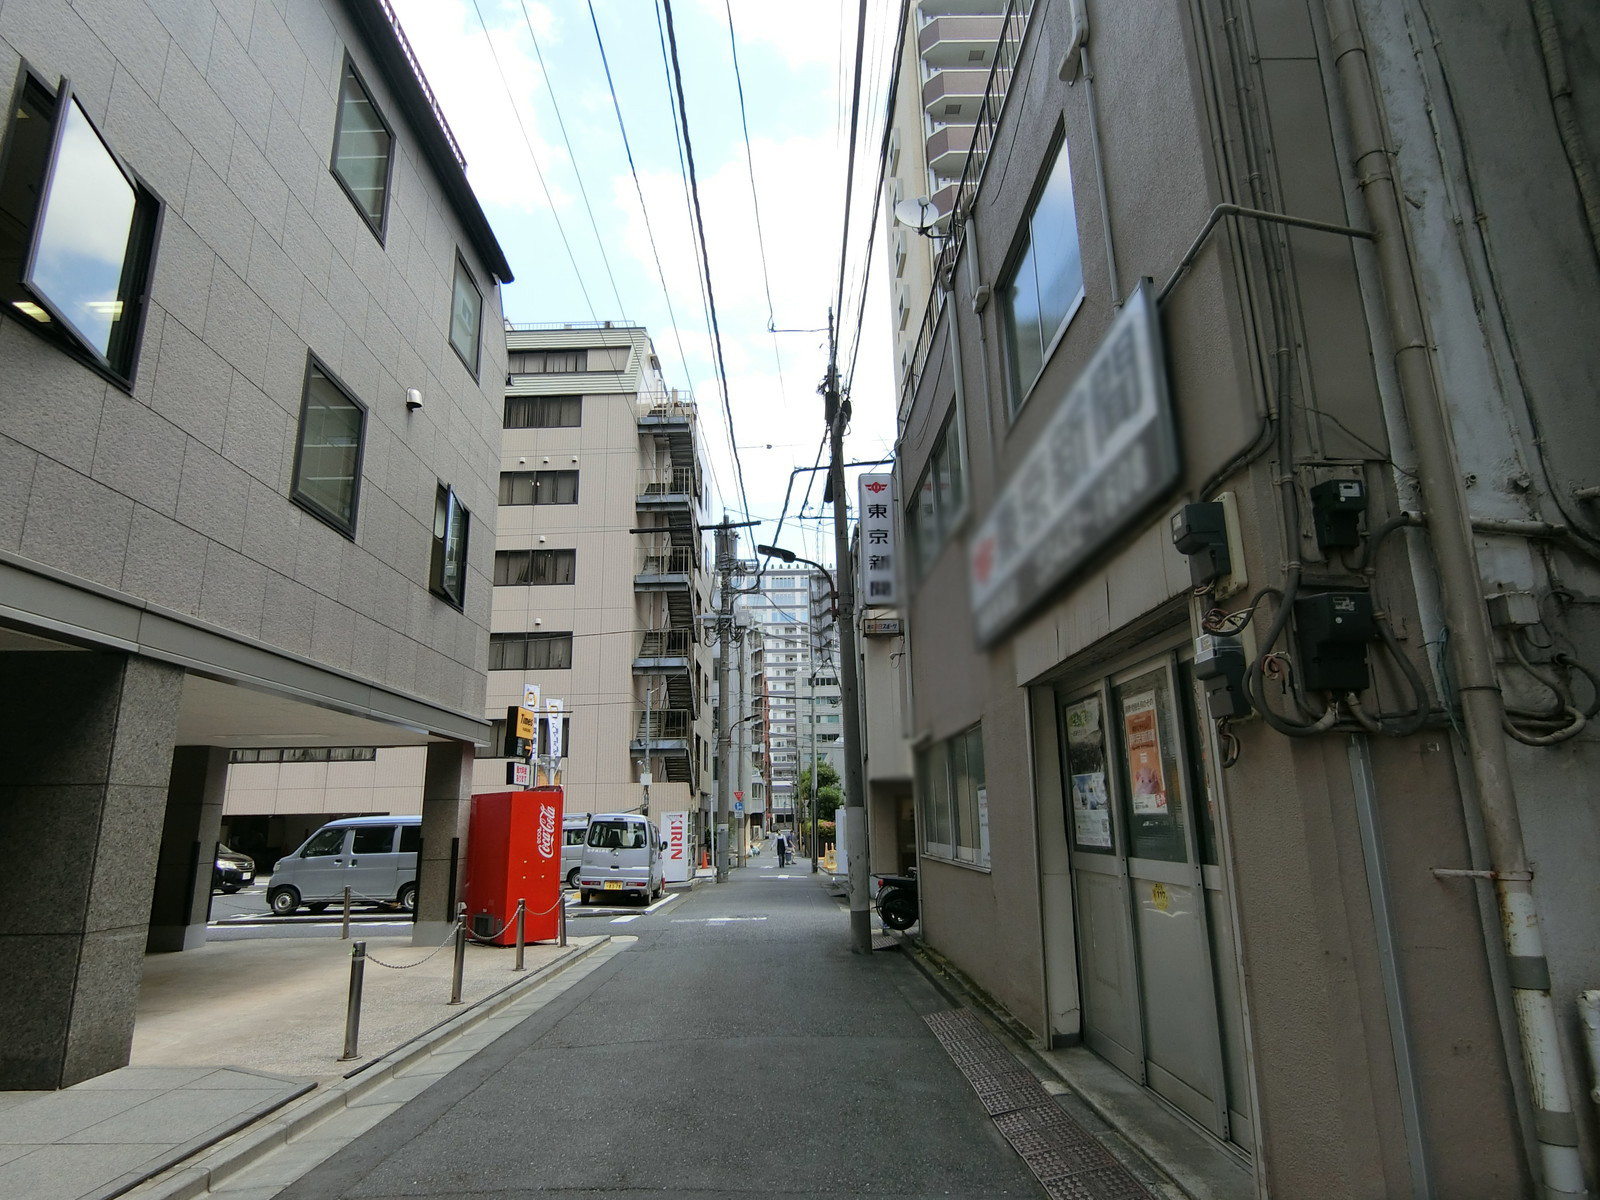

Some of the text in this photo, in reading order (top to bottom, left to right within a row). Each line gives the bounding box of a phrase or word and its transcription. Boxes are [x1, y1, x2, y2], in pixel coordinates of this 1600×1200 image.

[867, 503, 892, 597] 東京新
[521, 713, 534, 727] Times
[538, 803, 556, 858] Coca-Cola
[667, 814, 683, 860] KIRIN
